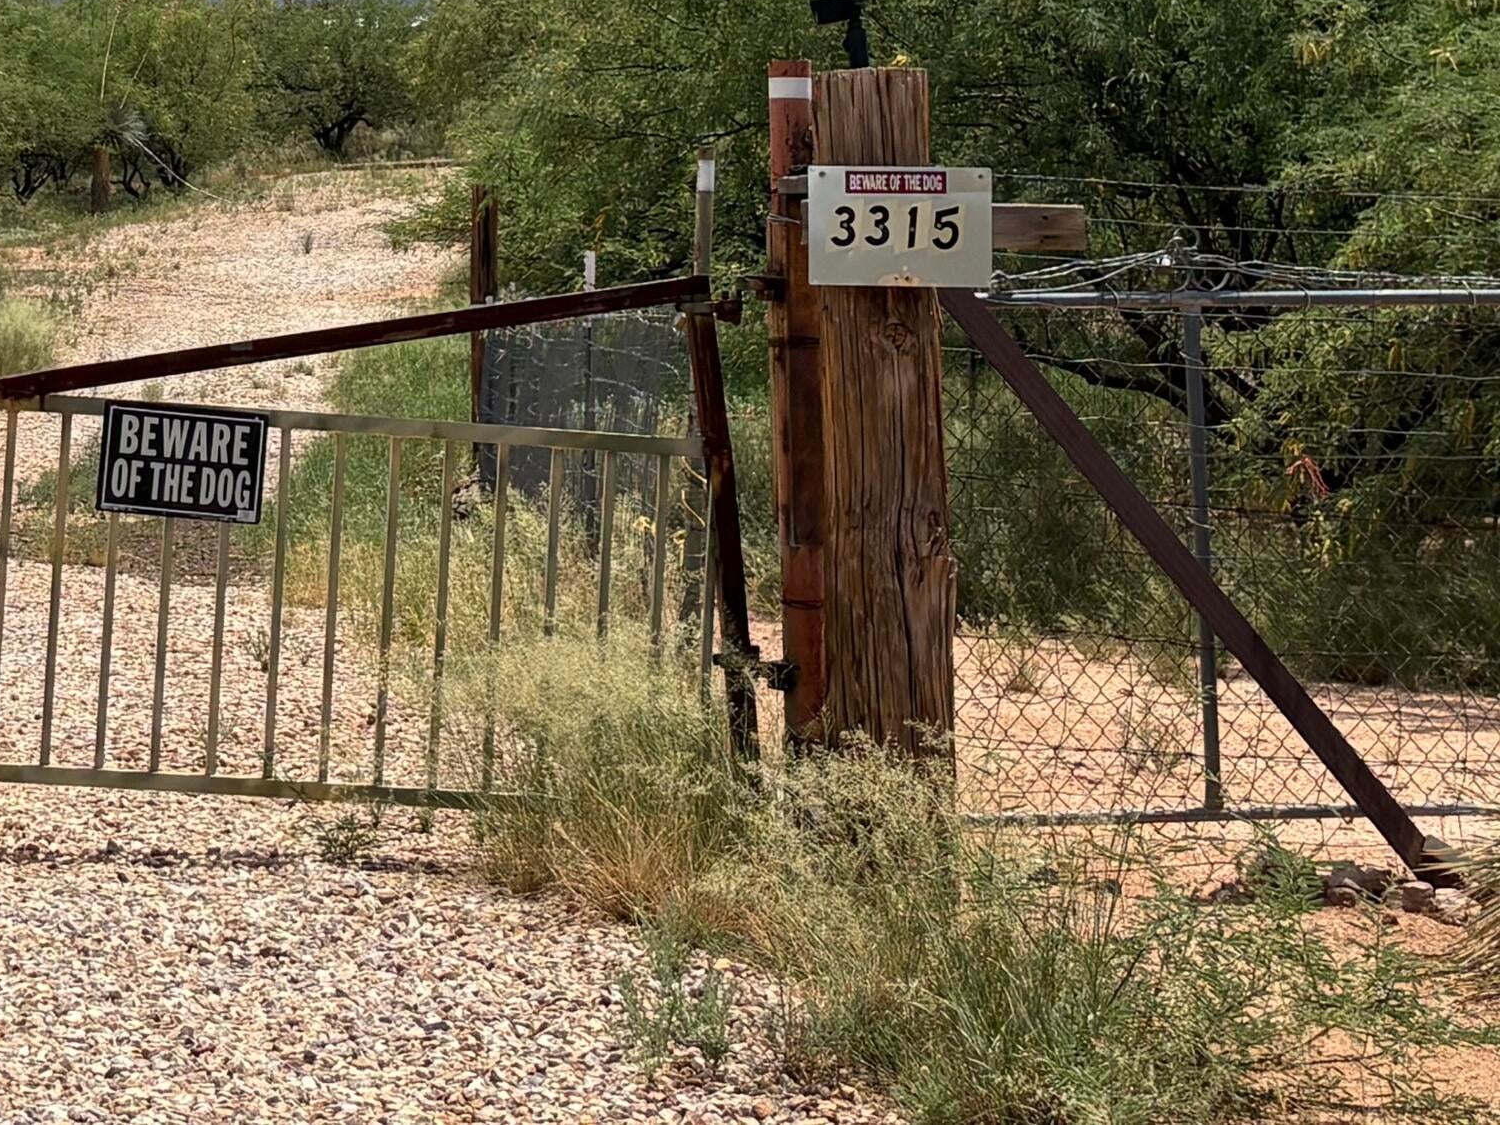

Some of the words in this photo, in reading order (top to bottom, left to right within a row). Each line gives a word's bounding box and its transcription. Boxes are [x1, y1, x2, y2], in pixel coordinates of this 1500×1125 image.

[849, 174, 887, 191] BEWARE
[889, 174, 901, 191] OF
[904, 174, 922, 191] THE
[923, 174, 943, 191] DOG
[830, 205, 960, 250] 3315
[119, 414, 250, 466] BEWARE
[111, 458, 144, 499] OF
[150, 461, 196, 504] THE
[198, 466, 251, 510] DOG
